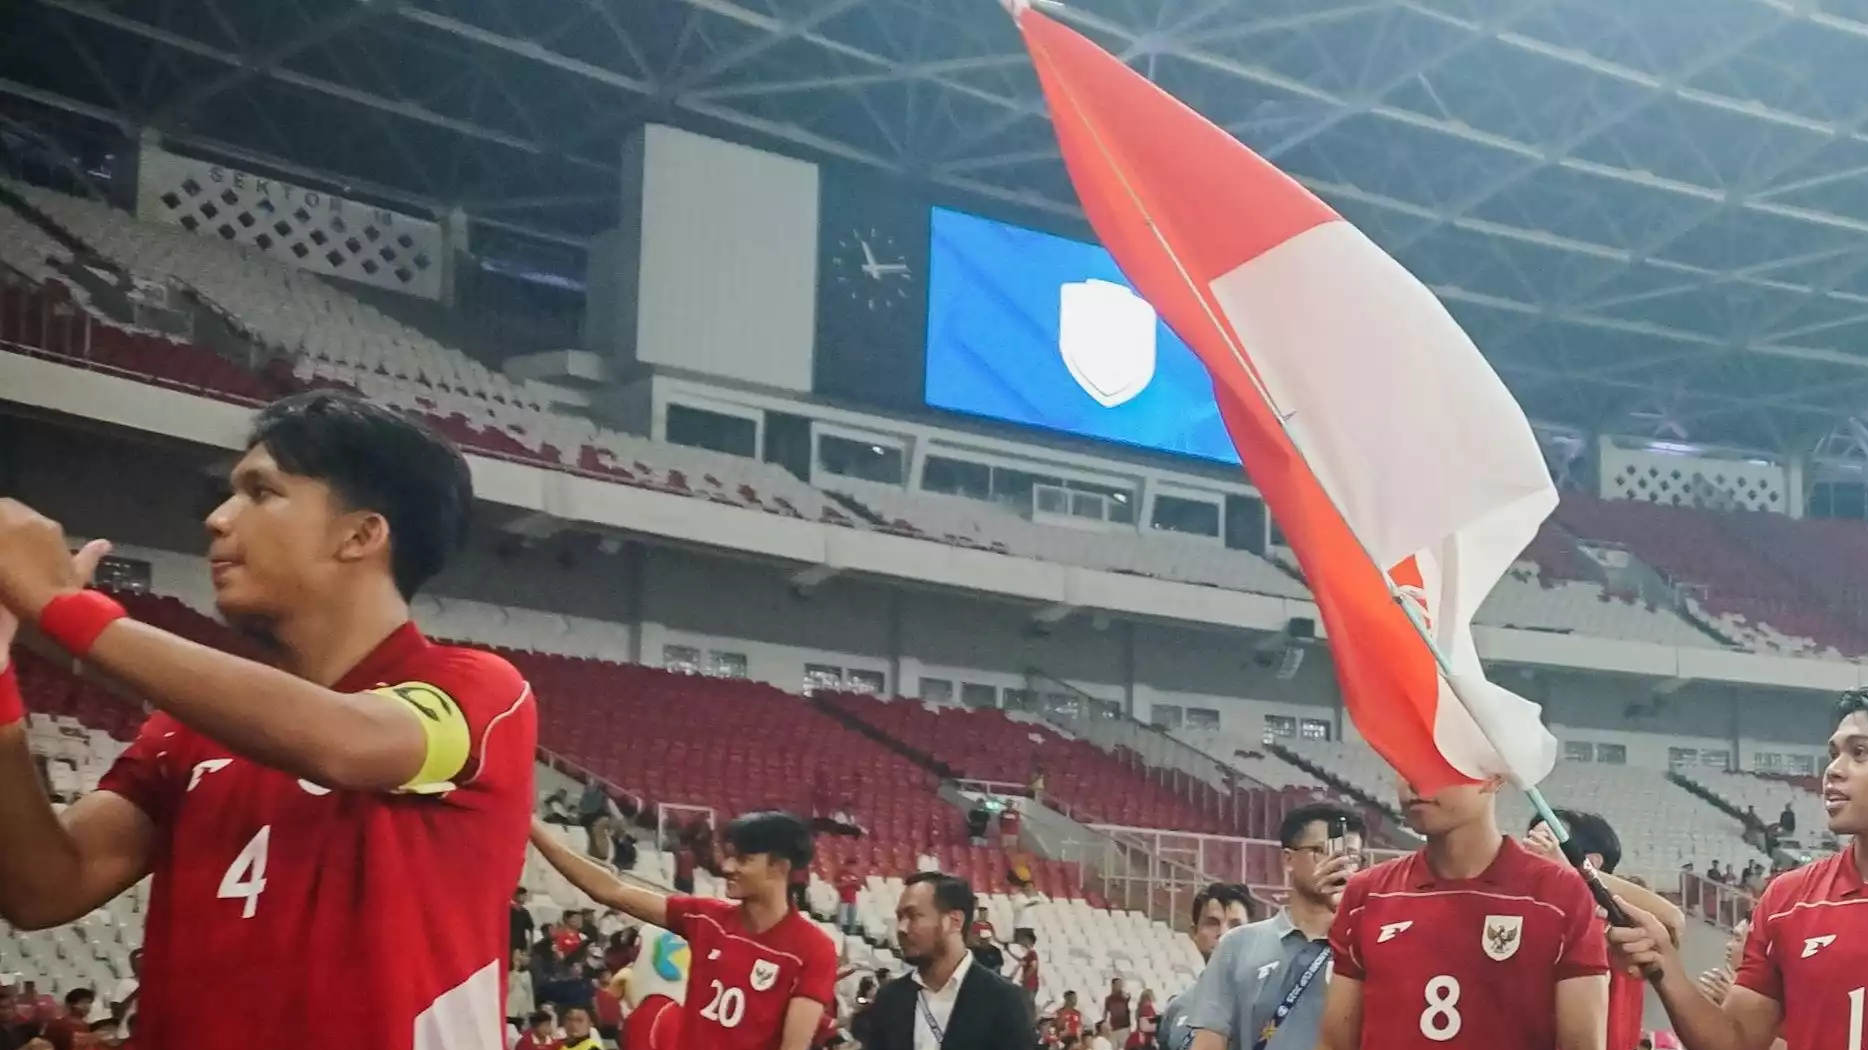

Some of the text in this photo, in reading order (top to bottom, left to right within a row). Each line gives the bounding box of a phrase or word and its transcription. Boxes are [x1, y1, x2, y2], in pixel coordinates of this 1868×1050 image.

[217, 824, 270, 919] 4
[700, 979, 745, 1028] 20
[1419, 974, 1462, 1041] 8
